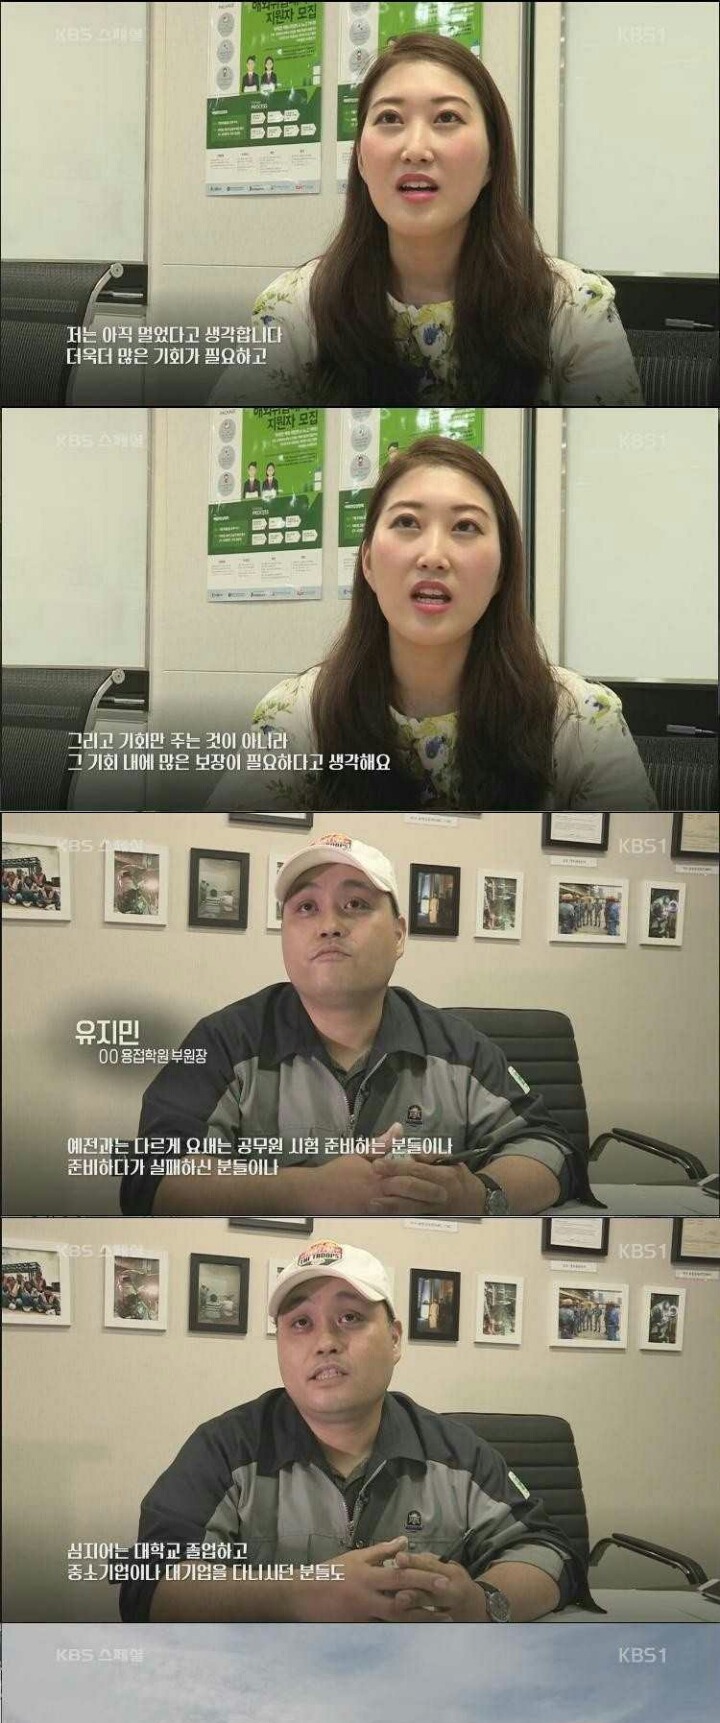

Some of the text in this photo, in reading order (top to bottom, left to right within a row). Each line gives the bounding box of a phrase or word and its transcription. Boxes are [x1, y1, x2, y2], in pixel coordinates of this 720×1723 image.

[266, 8, 294, 25] 지원자
[297, 4, 317, 20] 모집
[267, 414, 295, 431] 지원자
[298, 410, 318, 426] 모집
